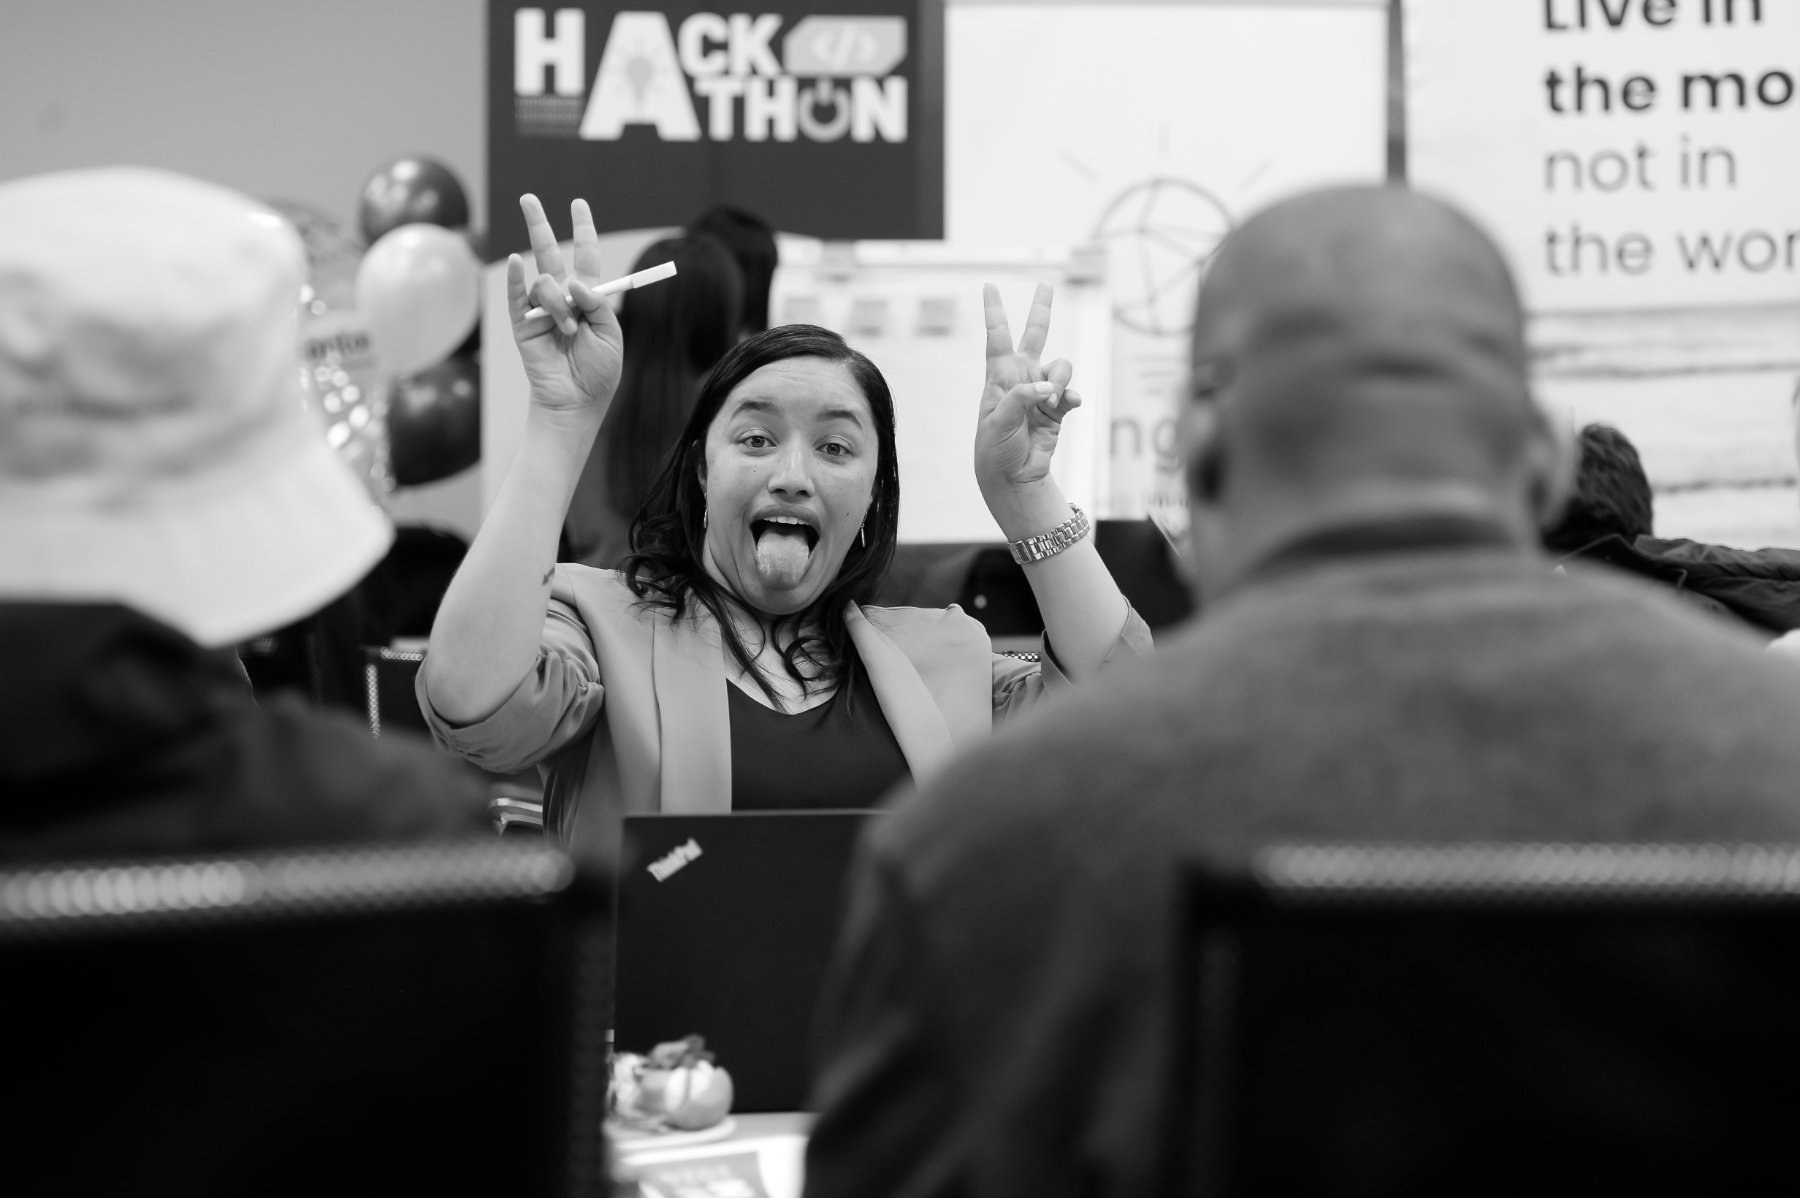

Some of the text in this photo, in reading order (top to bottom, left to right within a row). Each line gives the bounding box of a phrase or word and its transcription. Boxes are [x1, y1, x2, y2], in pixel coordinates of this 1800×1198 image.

[1545, 66, 1795, 113] the mo
[1545, 134, 1738, 192] not in
[1545, 223, 1654, 276] the
